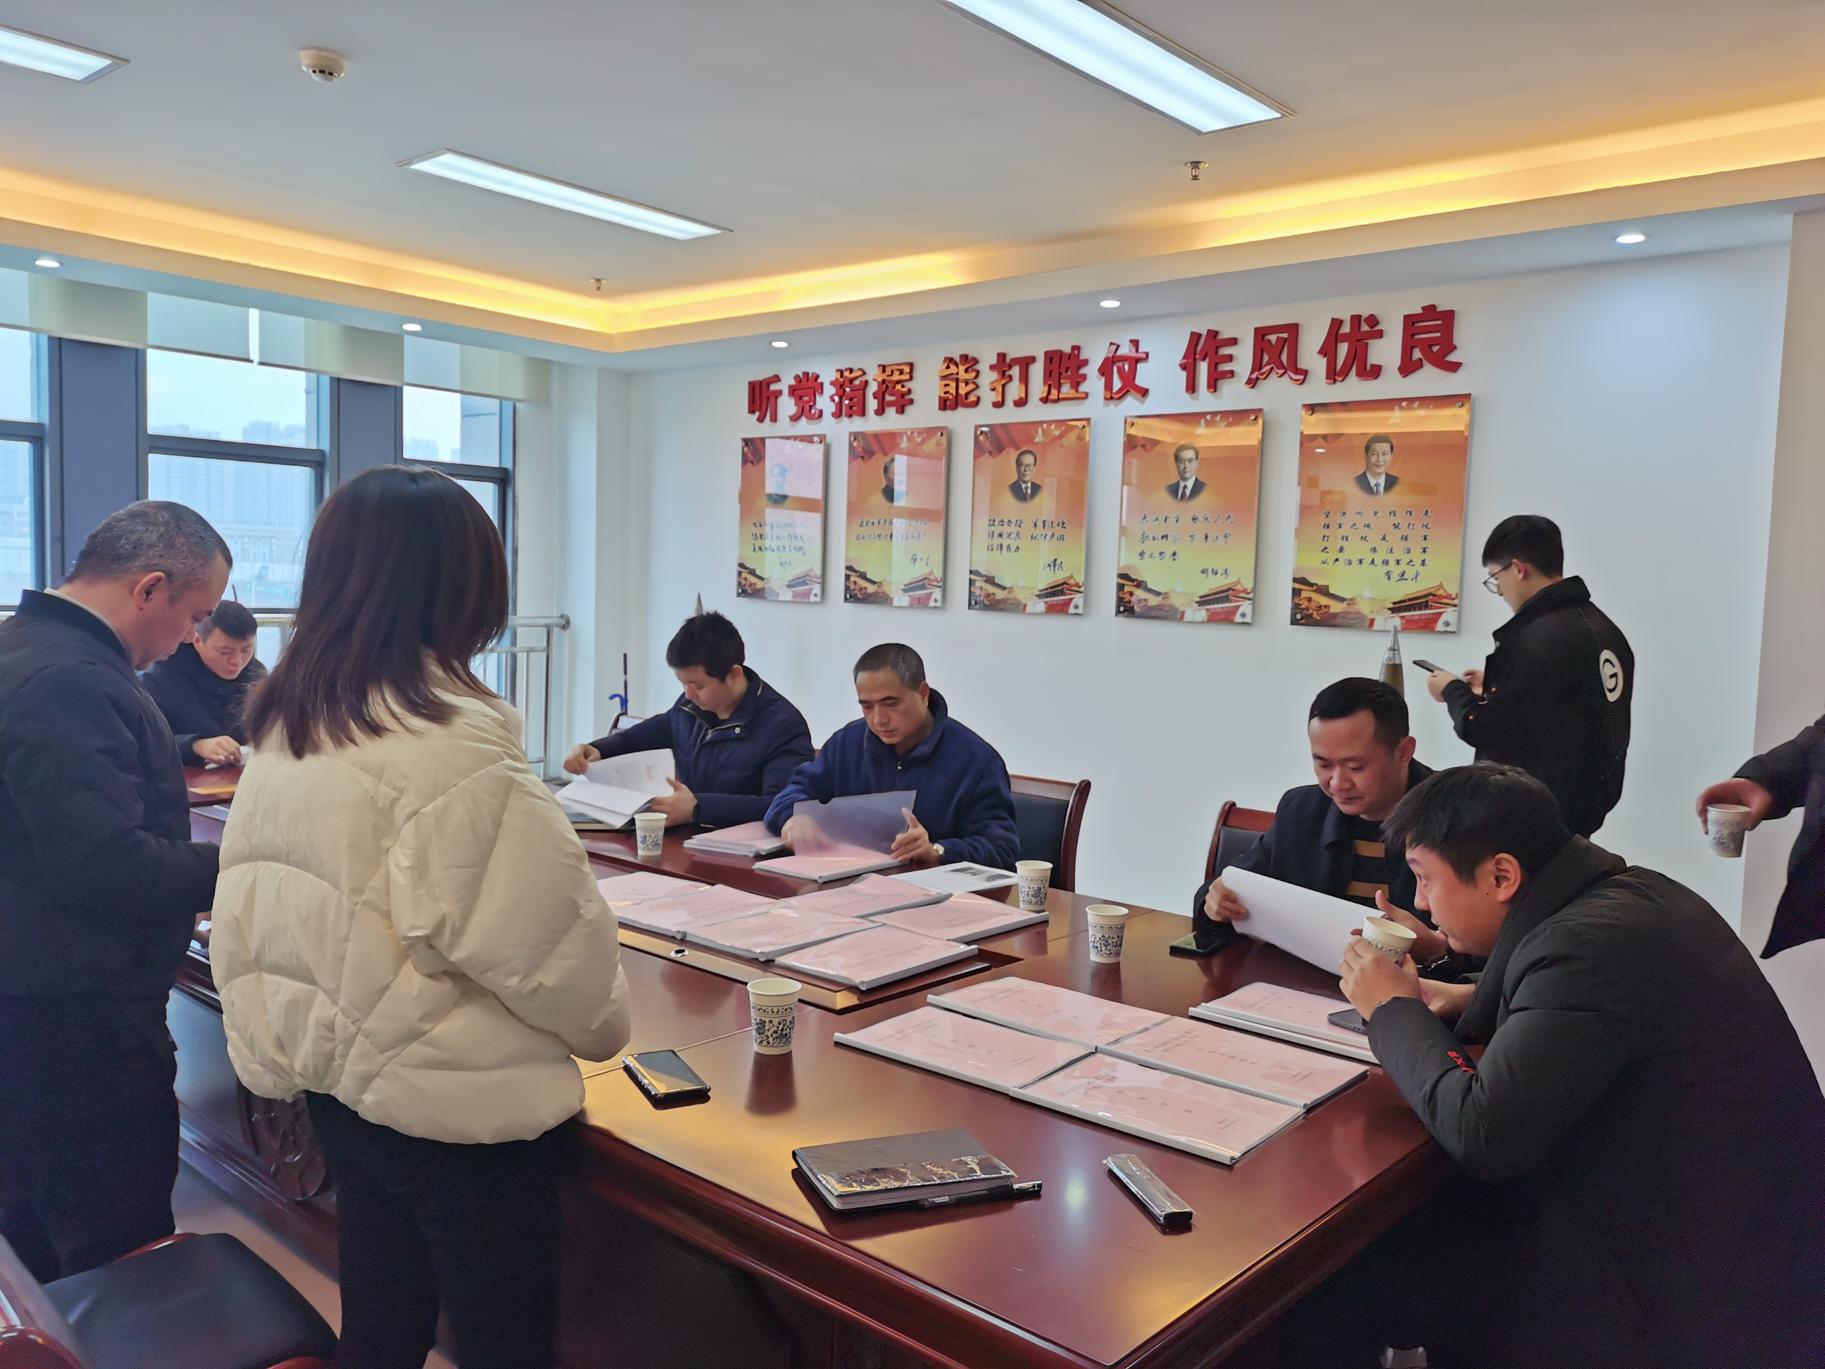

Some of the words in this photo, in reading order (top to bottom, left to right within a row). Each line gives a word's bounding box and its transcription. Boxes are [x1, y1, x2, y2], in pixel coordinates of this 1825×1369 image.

[747, 361, 915, 423] 听党指挥
[937, 338, 1150, 412] 能打胜仗
[1179, 303, 1464, 395] 作风优良
